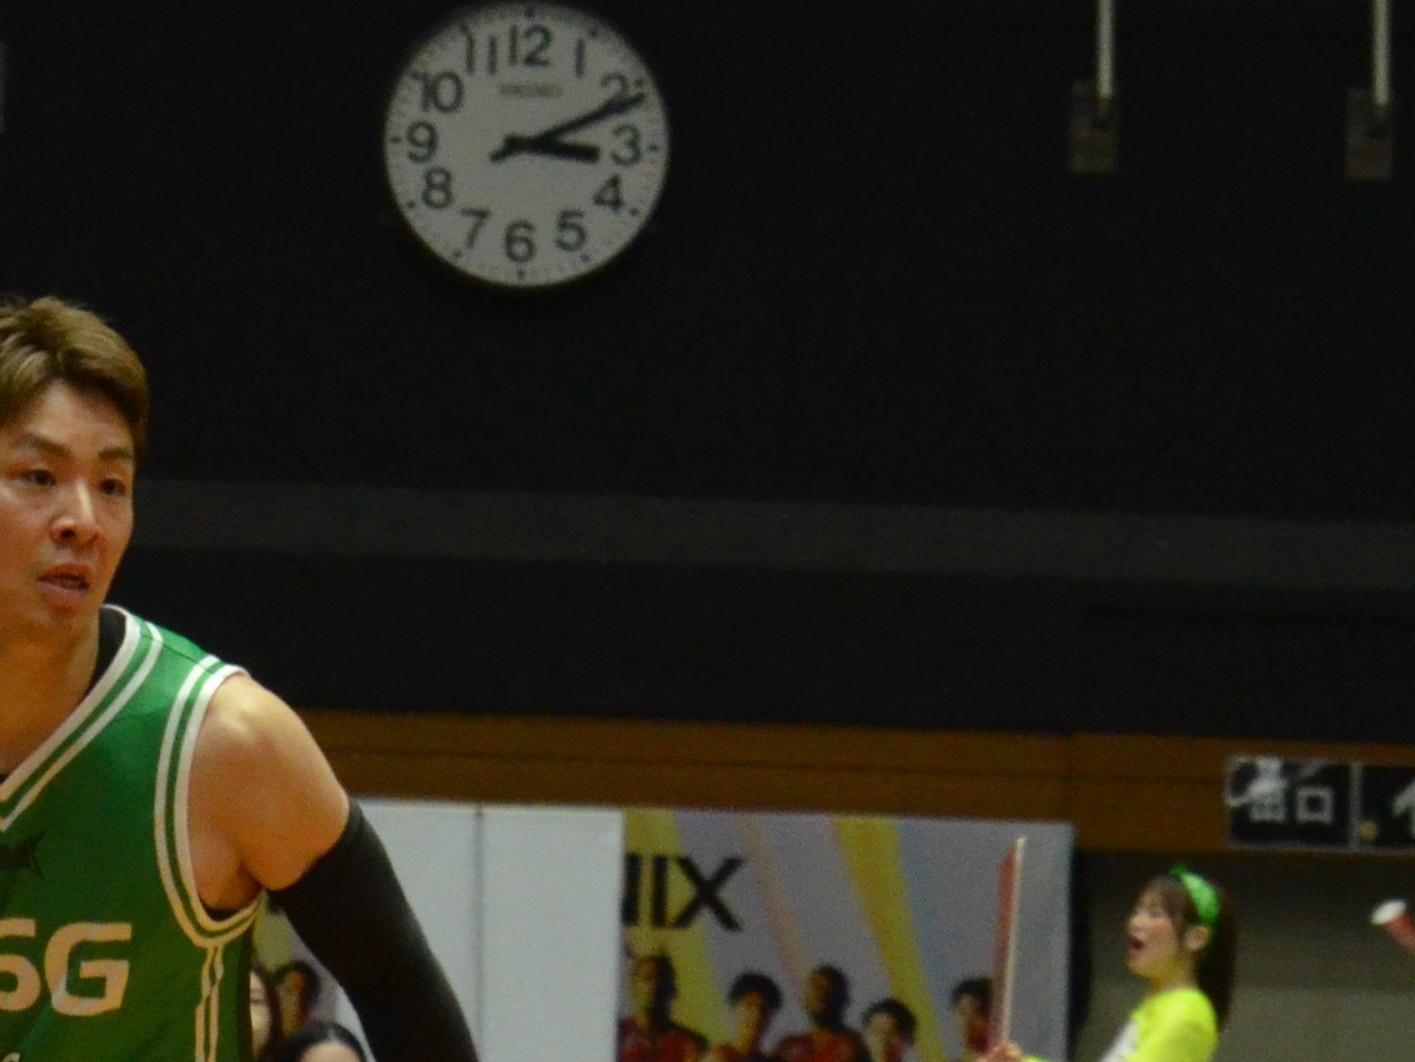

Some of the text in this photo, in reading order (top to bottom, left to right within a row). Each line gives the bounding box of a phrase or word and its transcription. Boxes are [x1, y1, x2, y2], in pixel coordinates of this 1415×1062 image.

[459, 23, 496, 75] 11
[510, 24, 552, 67] 12
[574, 37, 586, 78] 1
[412, 70, 465, 114] 10
[406, 121, 438, 164] 9
[610, 125, 641, 167] 3
[421, 167, 453, 209] 8
[594, 174, 624, 211] 4
[461, 208, 491, 248] 7
[505, 219, 535, 263] 6
[555, 209, 586, 252] 5
